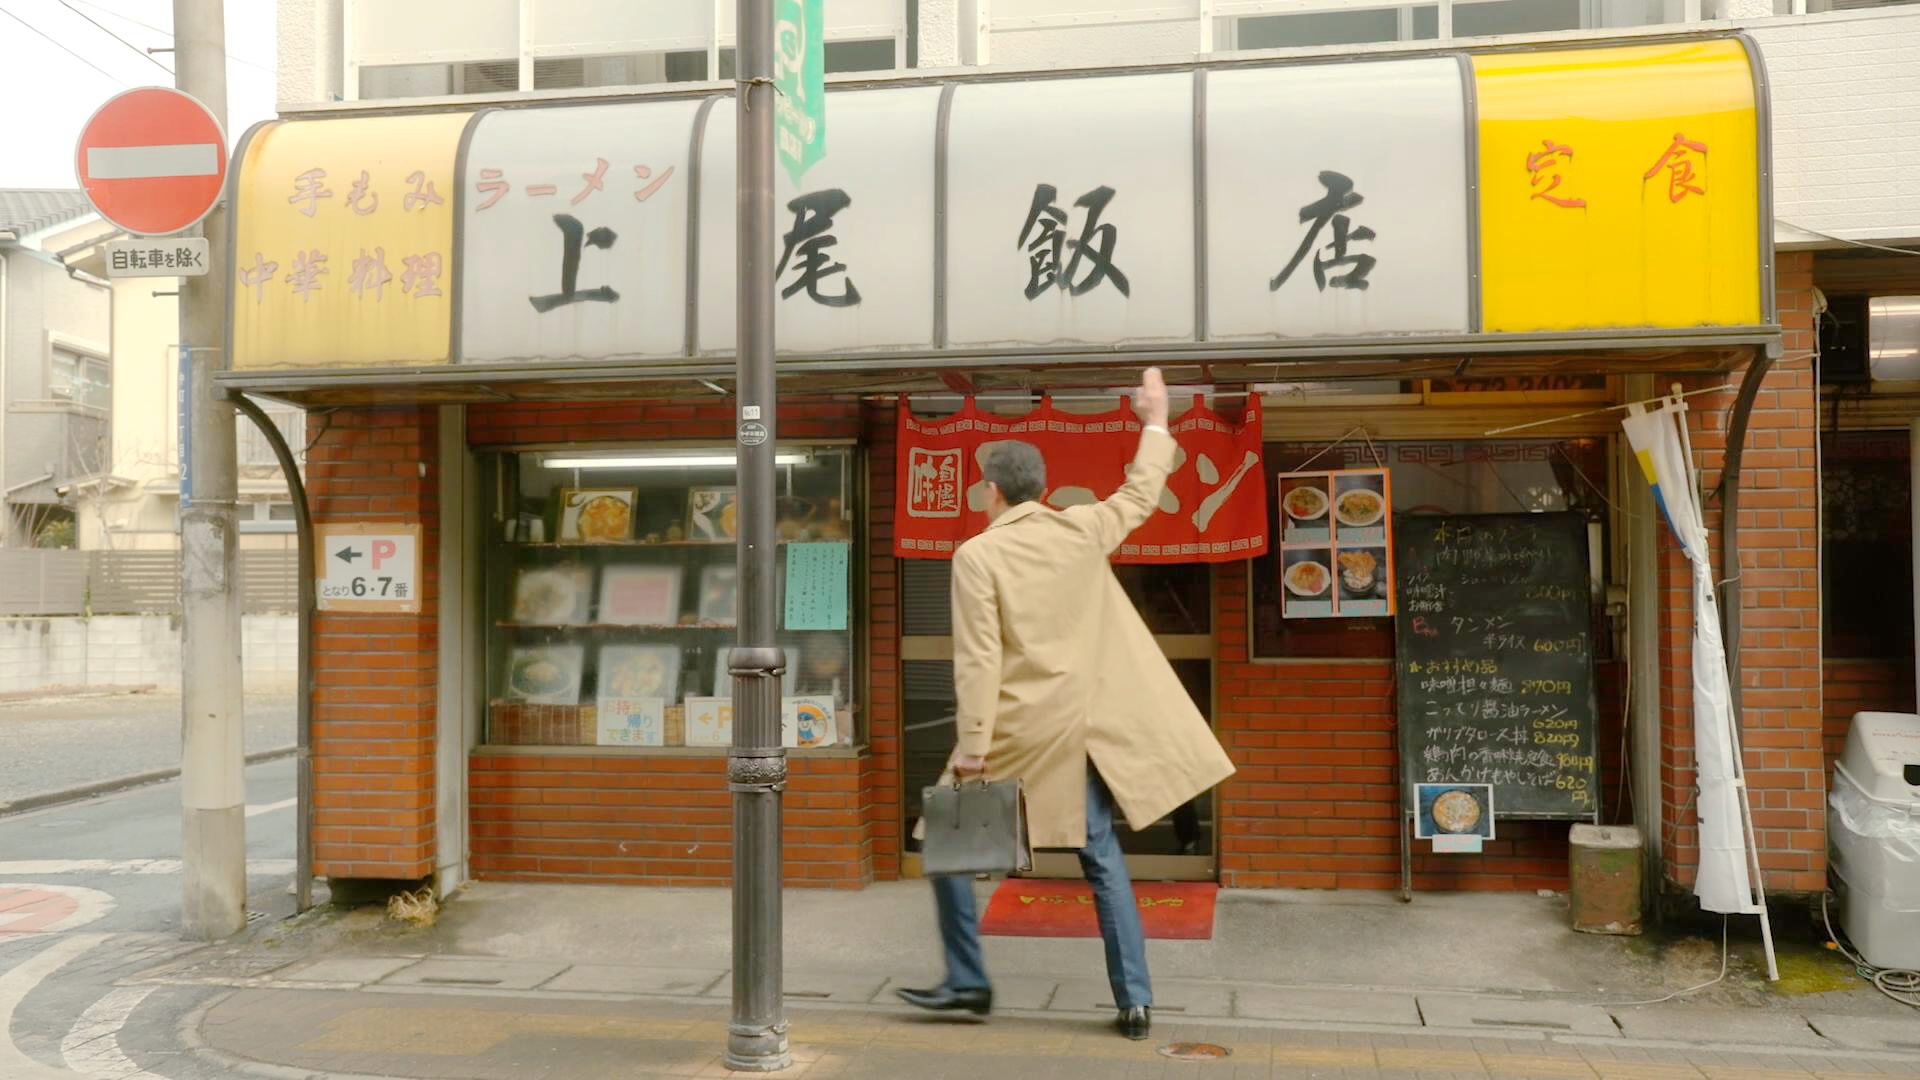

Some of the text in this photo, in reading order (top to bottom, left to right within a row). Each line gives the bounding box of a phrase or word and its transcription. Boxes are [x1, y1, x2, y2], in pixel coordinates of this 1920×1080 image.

[288, 157, 677, 218] 手もみ ラーメン
[1526, 132, 1708, 208] 定食
[112, 247, 202, 269] 自転車を除く
[528, 170, 1377, 315] 上尾飯店
[239, 247, 444, 303] 中華料理
[372, 540, 396, 570] P
[1450, 615, 1516, 635] タンメン
[1482, 633, 1527, 650] 半ライス
